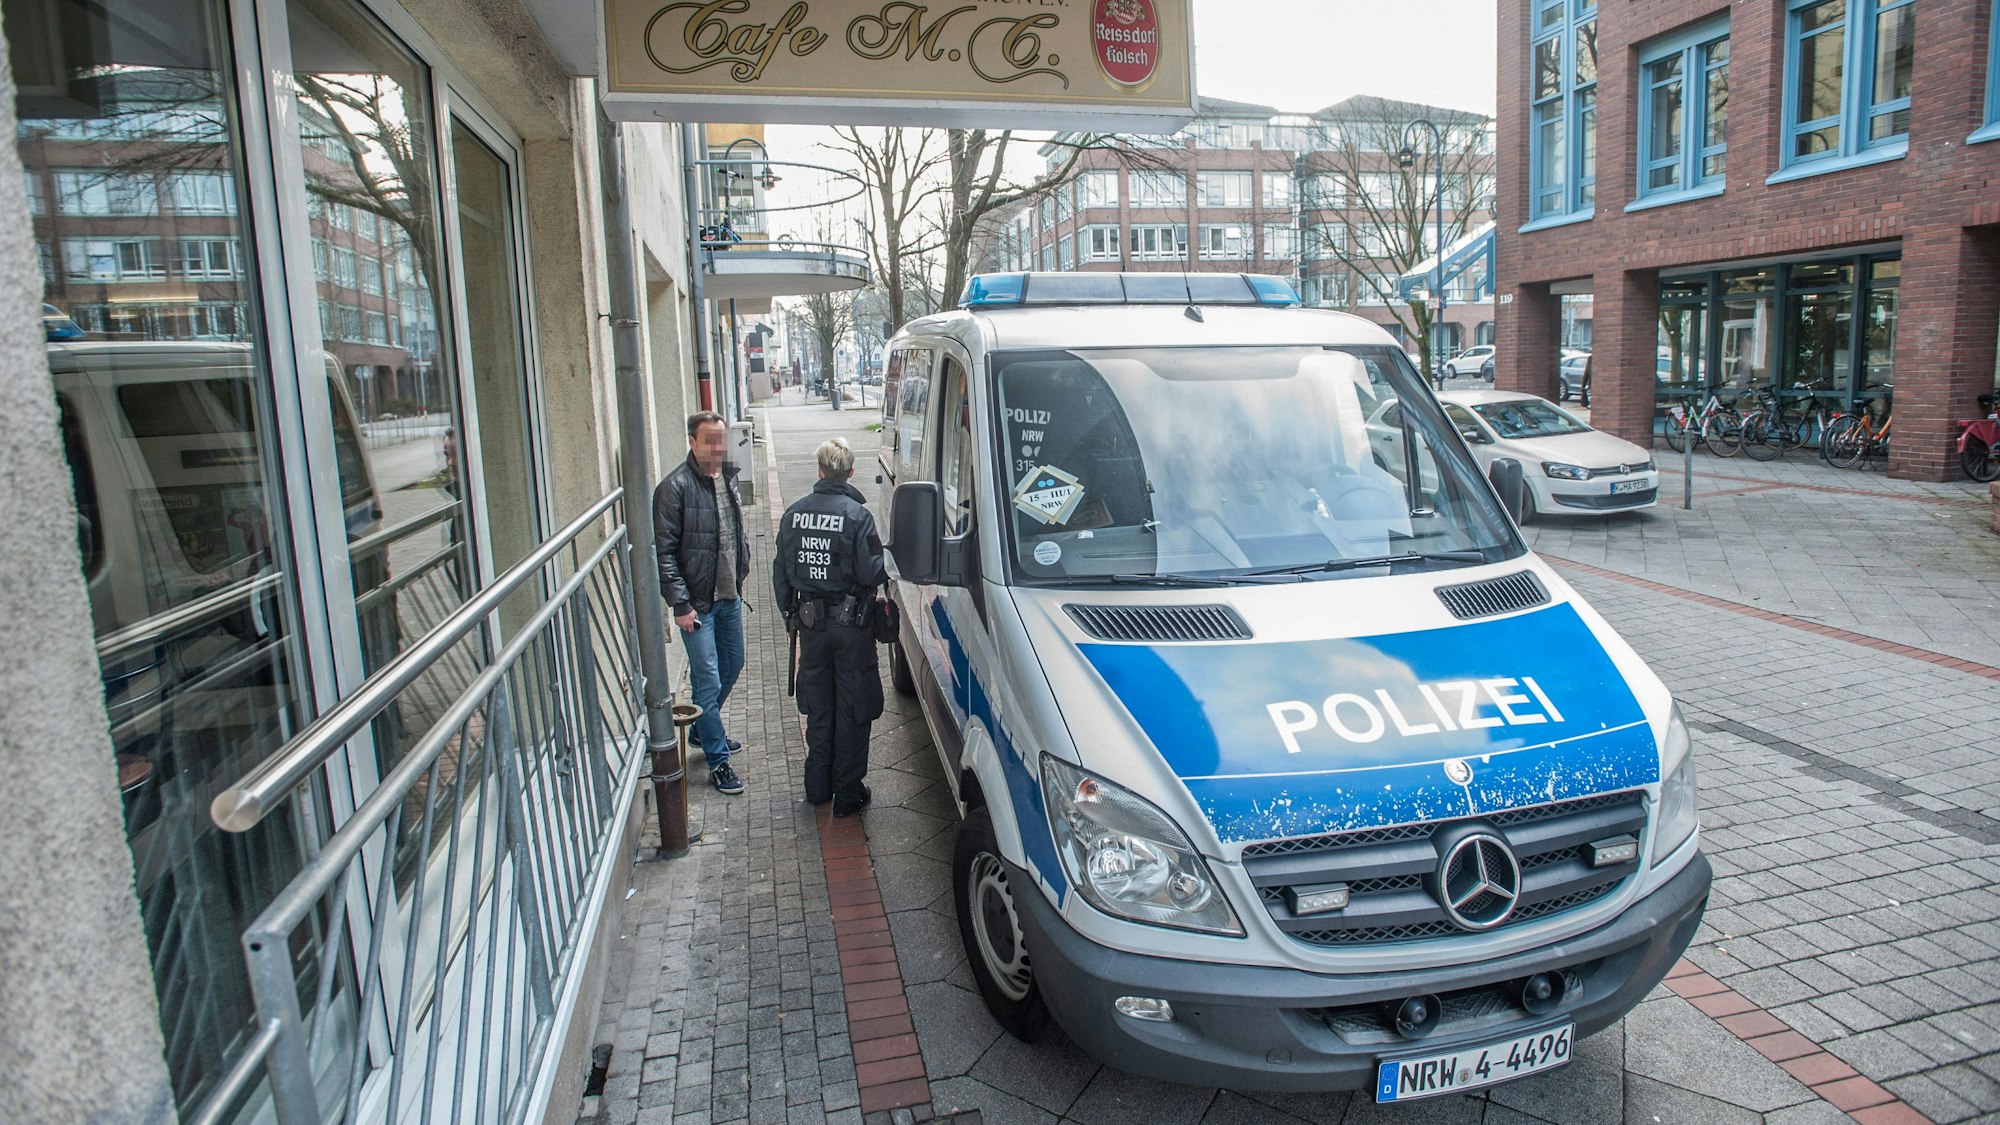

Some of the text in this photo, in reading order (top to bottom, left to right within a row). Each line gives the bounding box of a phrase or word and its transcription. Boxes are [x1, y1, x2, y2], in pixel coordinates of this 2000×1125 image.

[644, 0, 828, 82] Cafe
[1096, 23, 1156, 44] Reissdorf
[1106, 45, 1148, 67] Kölsch
[1499, 293, 1513, 304] 119
[1021, 429, 1044, 442] NRW
[1030, 494, 1040, 502] 15
[1041, 500, 1062, 509] NRW
[792, 512, 845, 532] POLIZEI
[801, 536, 831, 551] NRW
[798, 551, 831, 565] 31533
[809, 567, 827, 580] RH
[1266, 676, 1565, 753] POLIZEI
[1383, 1028, 1568, 1094] D NRW 4-4496
